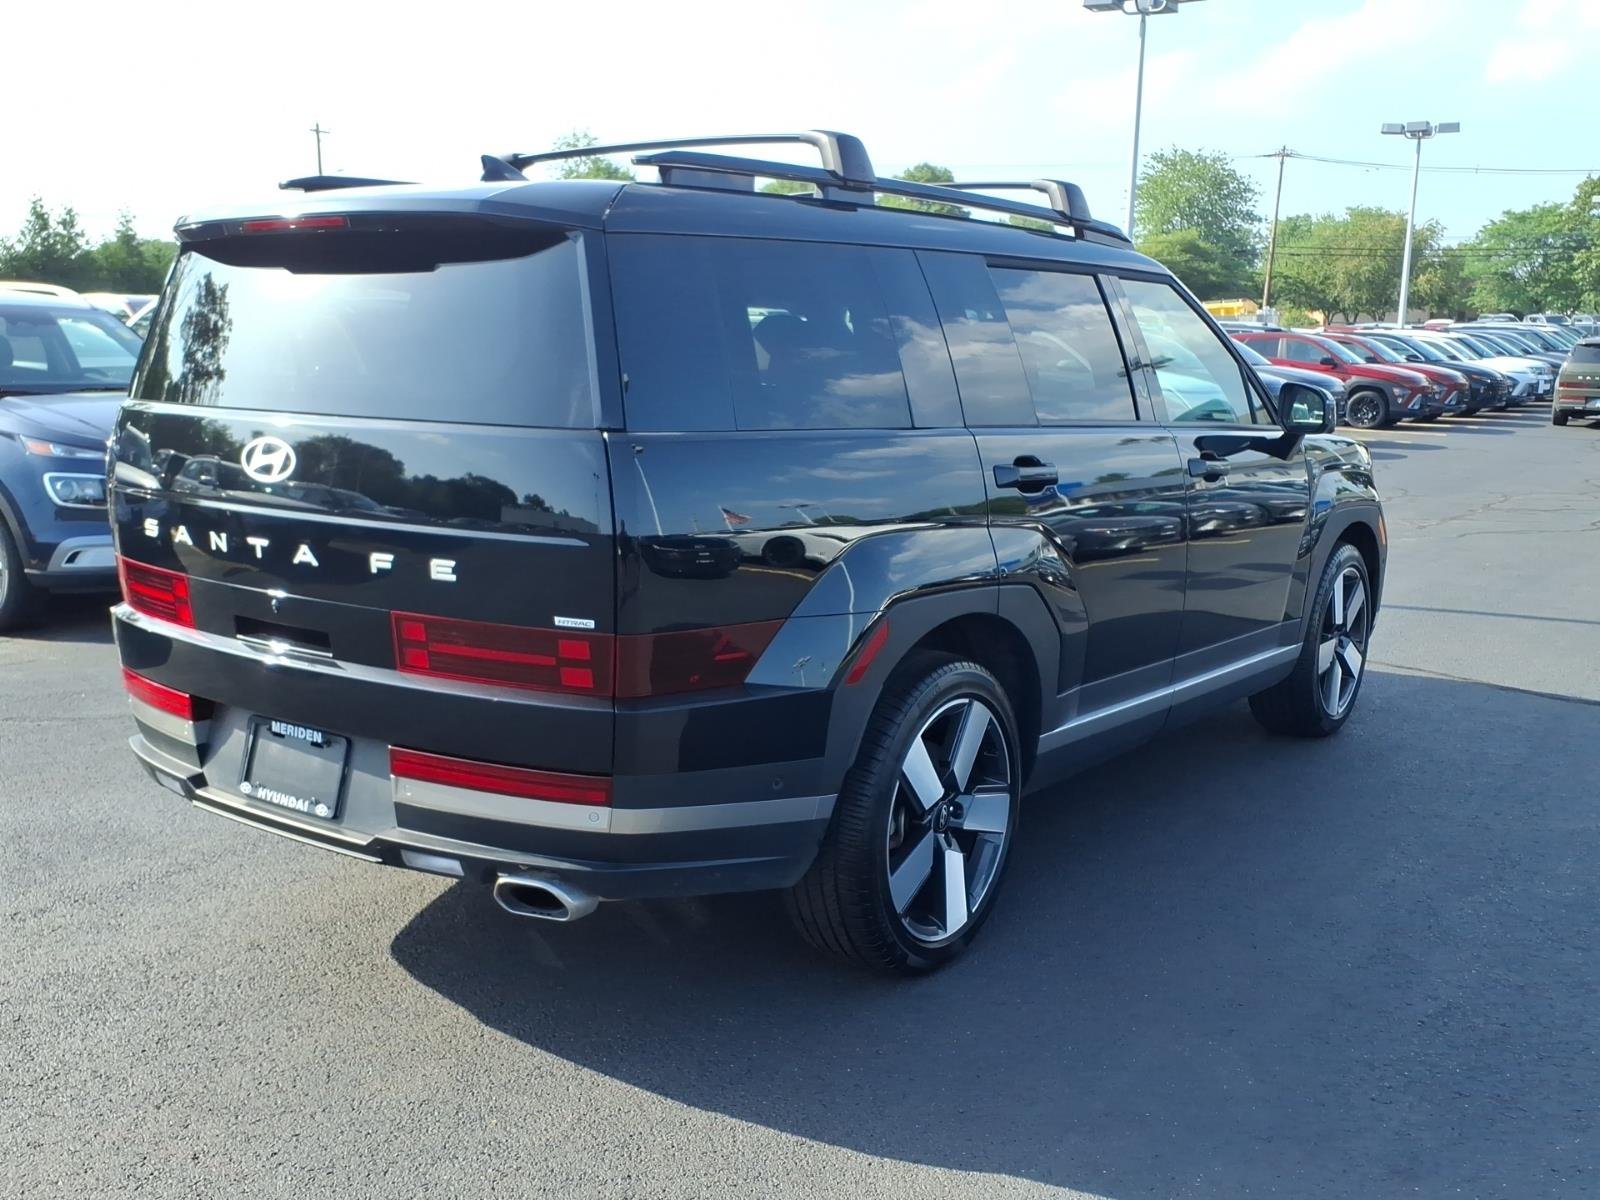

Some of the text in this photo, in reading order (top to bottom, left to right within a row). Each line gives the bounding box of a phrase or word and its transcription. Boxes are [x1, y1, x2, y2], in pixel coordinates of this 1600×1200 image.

[143, 517, 457, 582] SANTA FE
[271, 720, 322, 743] MERIDEN
[257, 787, 309, 812] HYUNDAI
